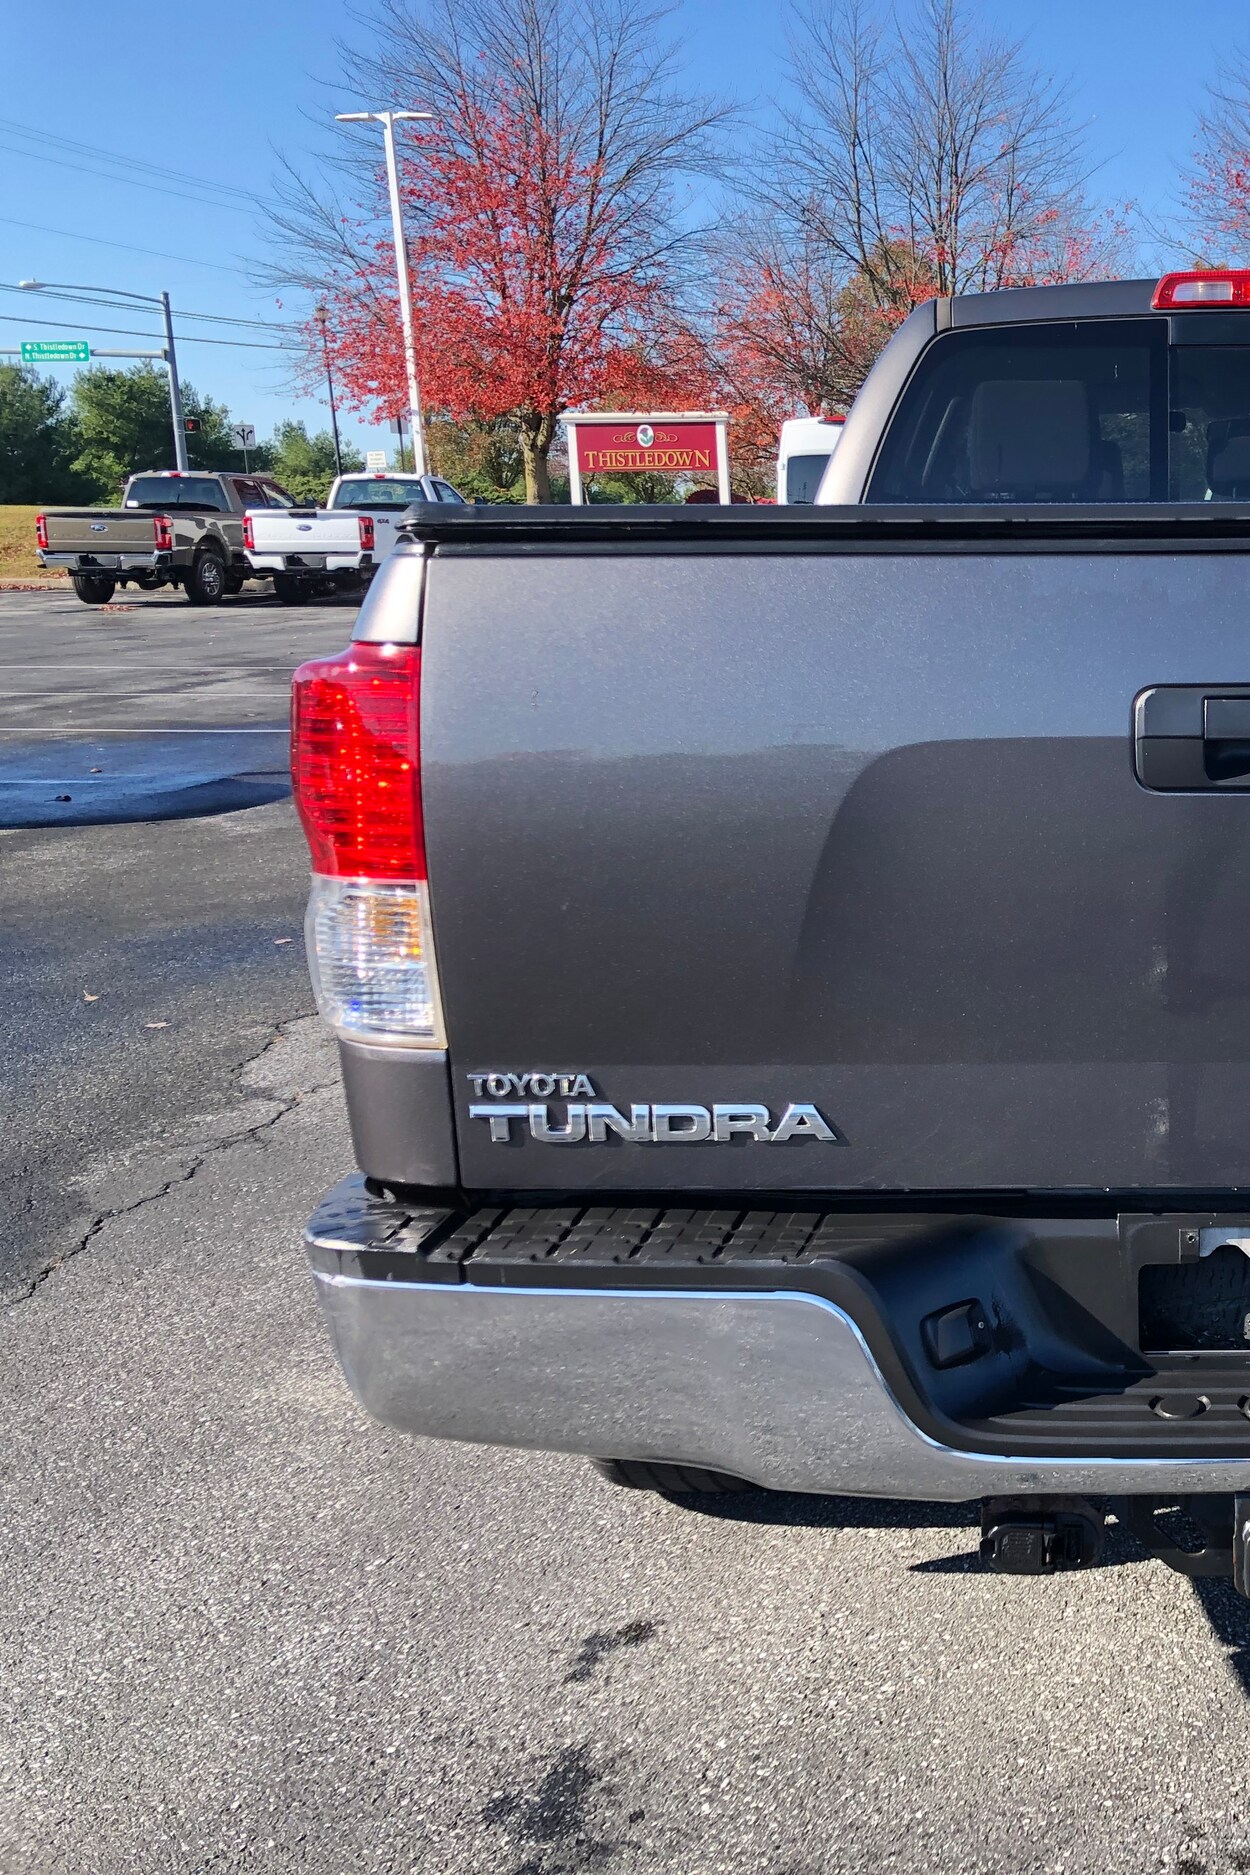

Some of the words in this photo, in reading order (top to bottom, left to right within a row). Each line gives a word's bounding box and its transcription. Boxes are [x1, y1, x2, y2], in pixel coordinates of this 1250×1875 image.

[32, 352, 69, 360] Thistledown
[69, 352, 77, 360] Dr
[40, 343, 77, 351] Thistledown
[77, 342, 85, 350] Dr
[584, 449, 711, 469] THISTLEDOWN
[466, 1072, 597, 1097] TOYOTA
[469, 1103, 838, 1143] TUNDRA
